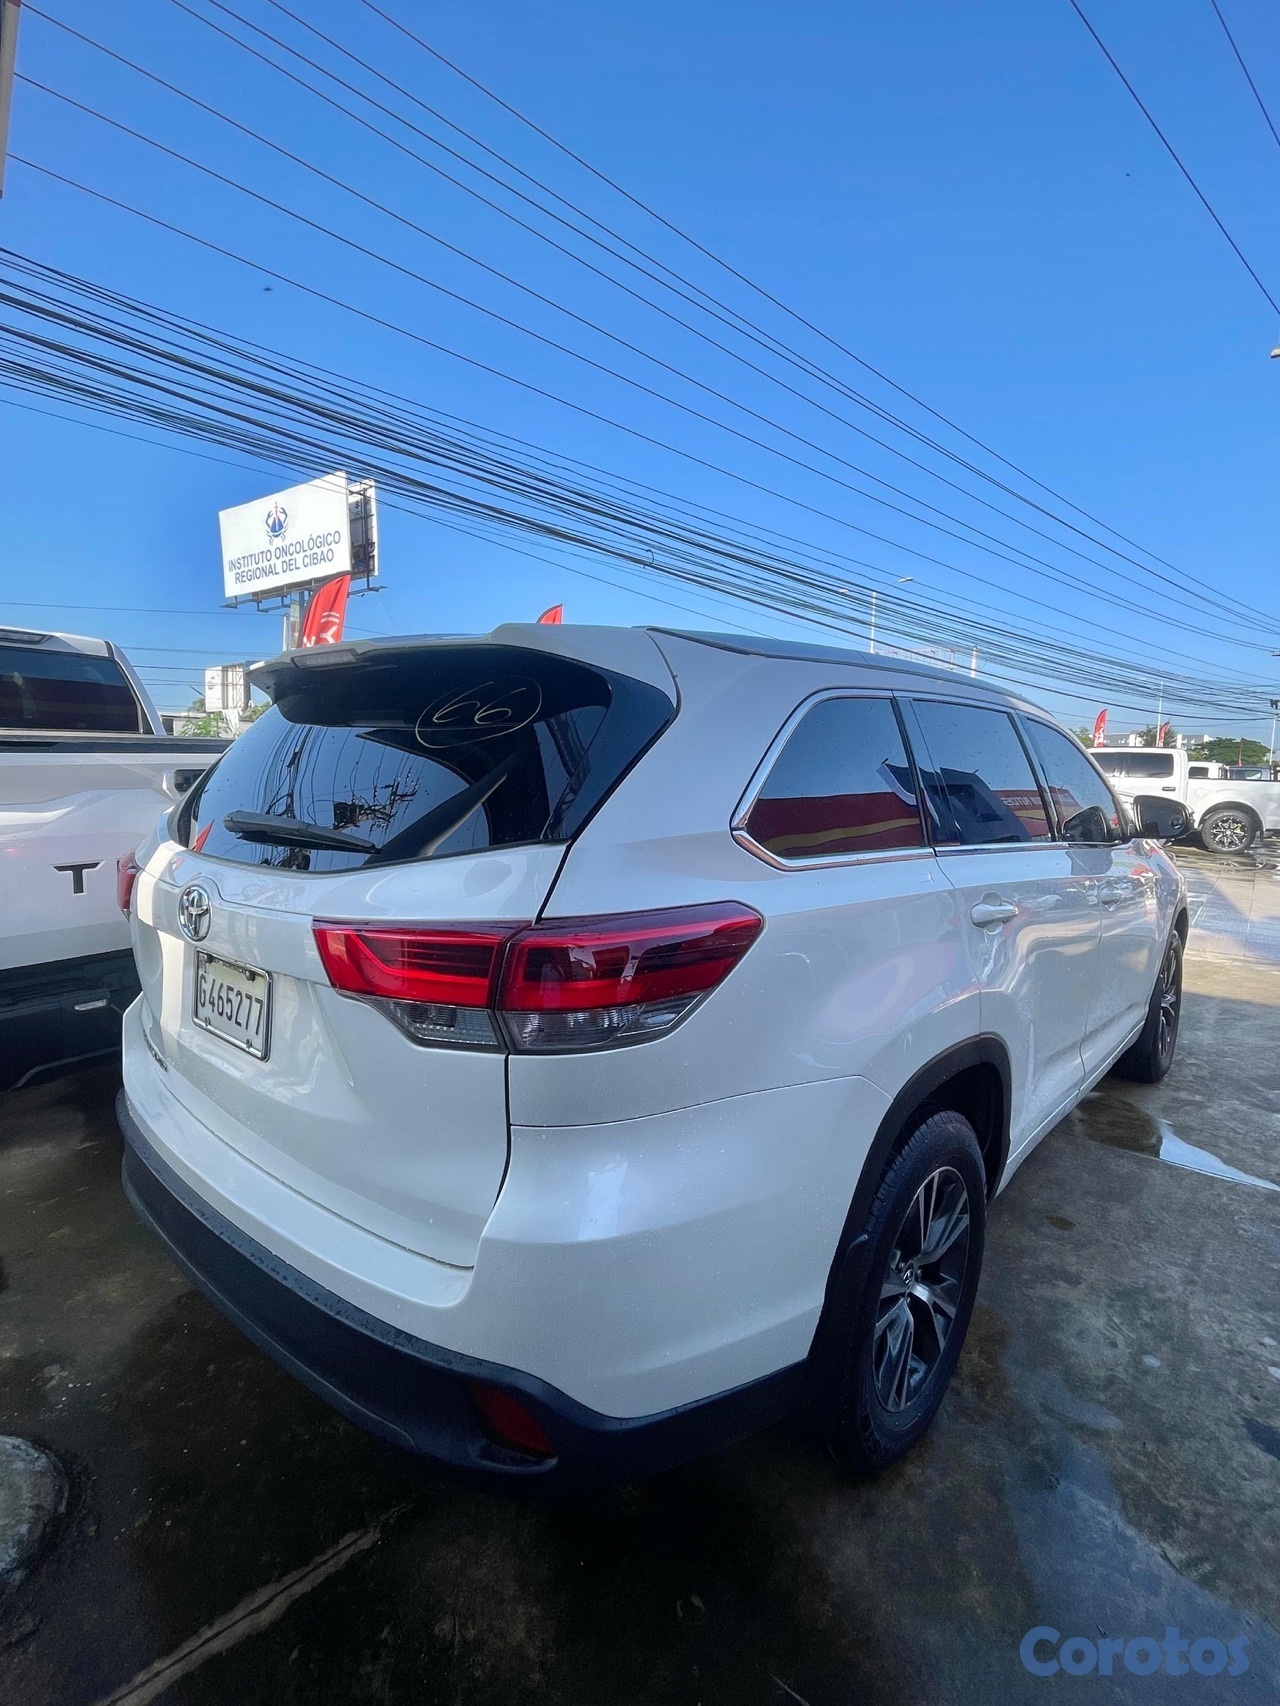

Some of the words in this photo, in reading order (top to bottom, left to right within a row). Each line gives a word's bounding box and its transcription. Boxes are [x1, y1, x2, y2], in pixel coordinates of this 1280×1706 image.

[228, 549, 272, 573] INSTITUTO
[274, 530, 341, 560] ONCOLÓGICO
[235, 563, 279, 585] REGIONAL
[282, 557, 300, 573] DEL
[302, 548, 334, 568] CIBAO
[199, 973, 264, 1036] G465277
